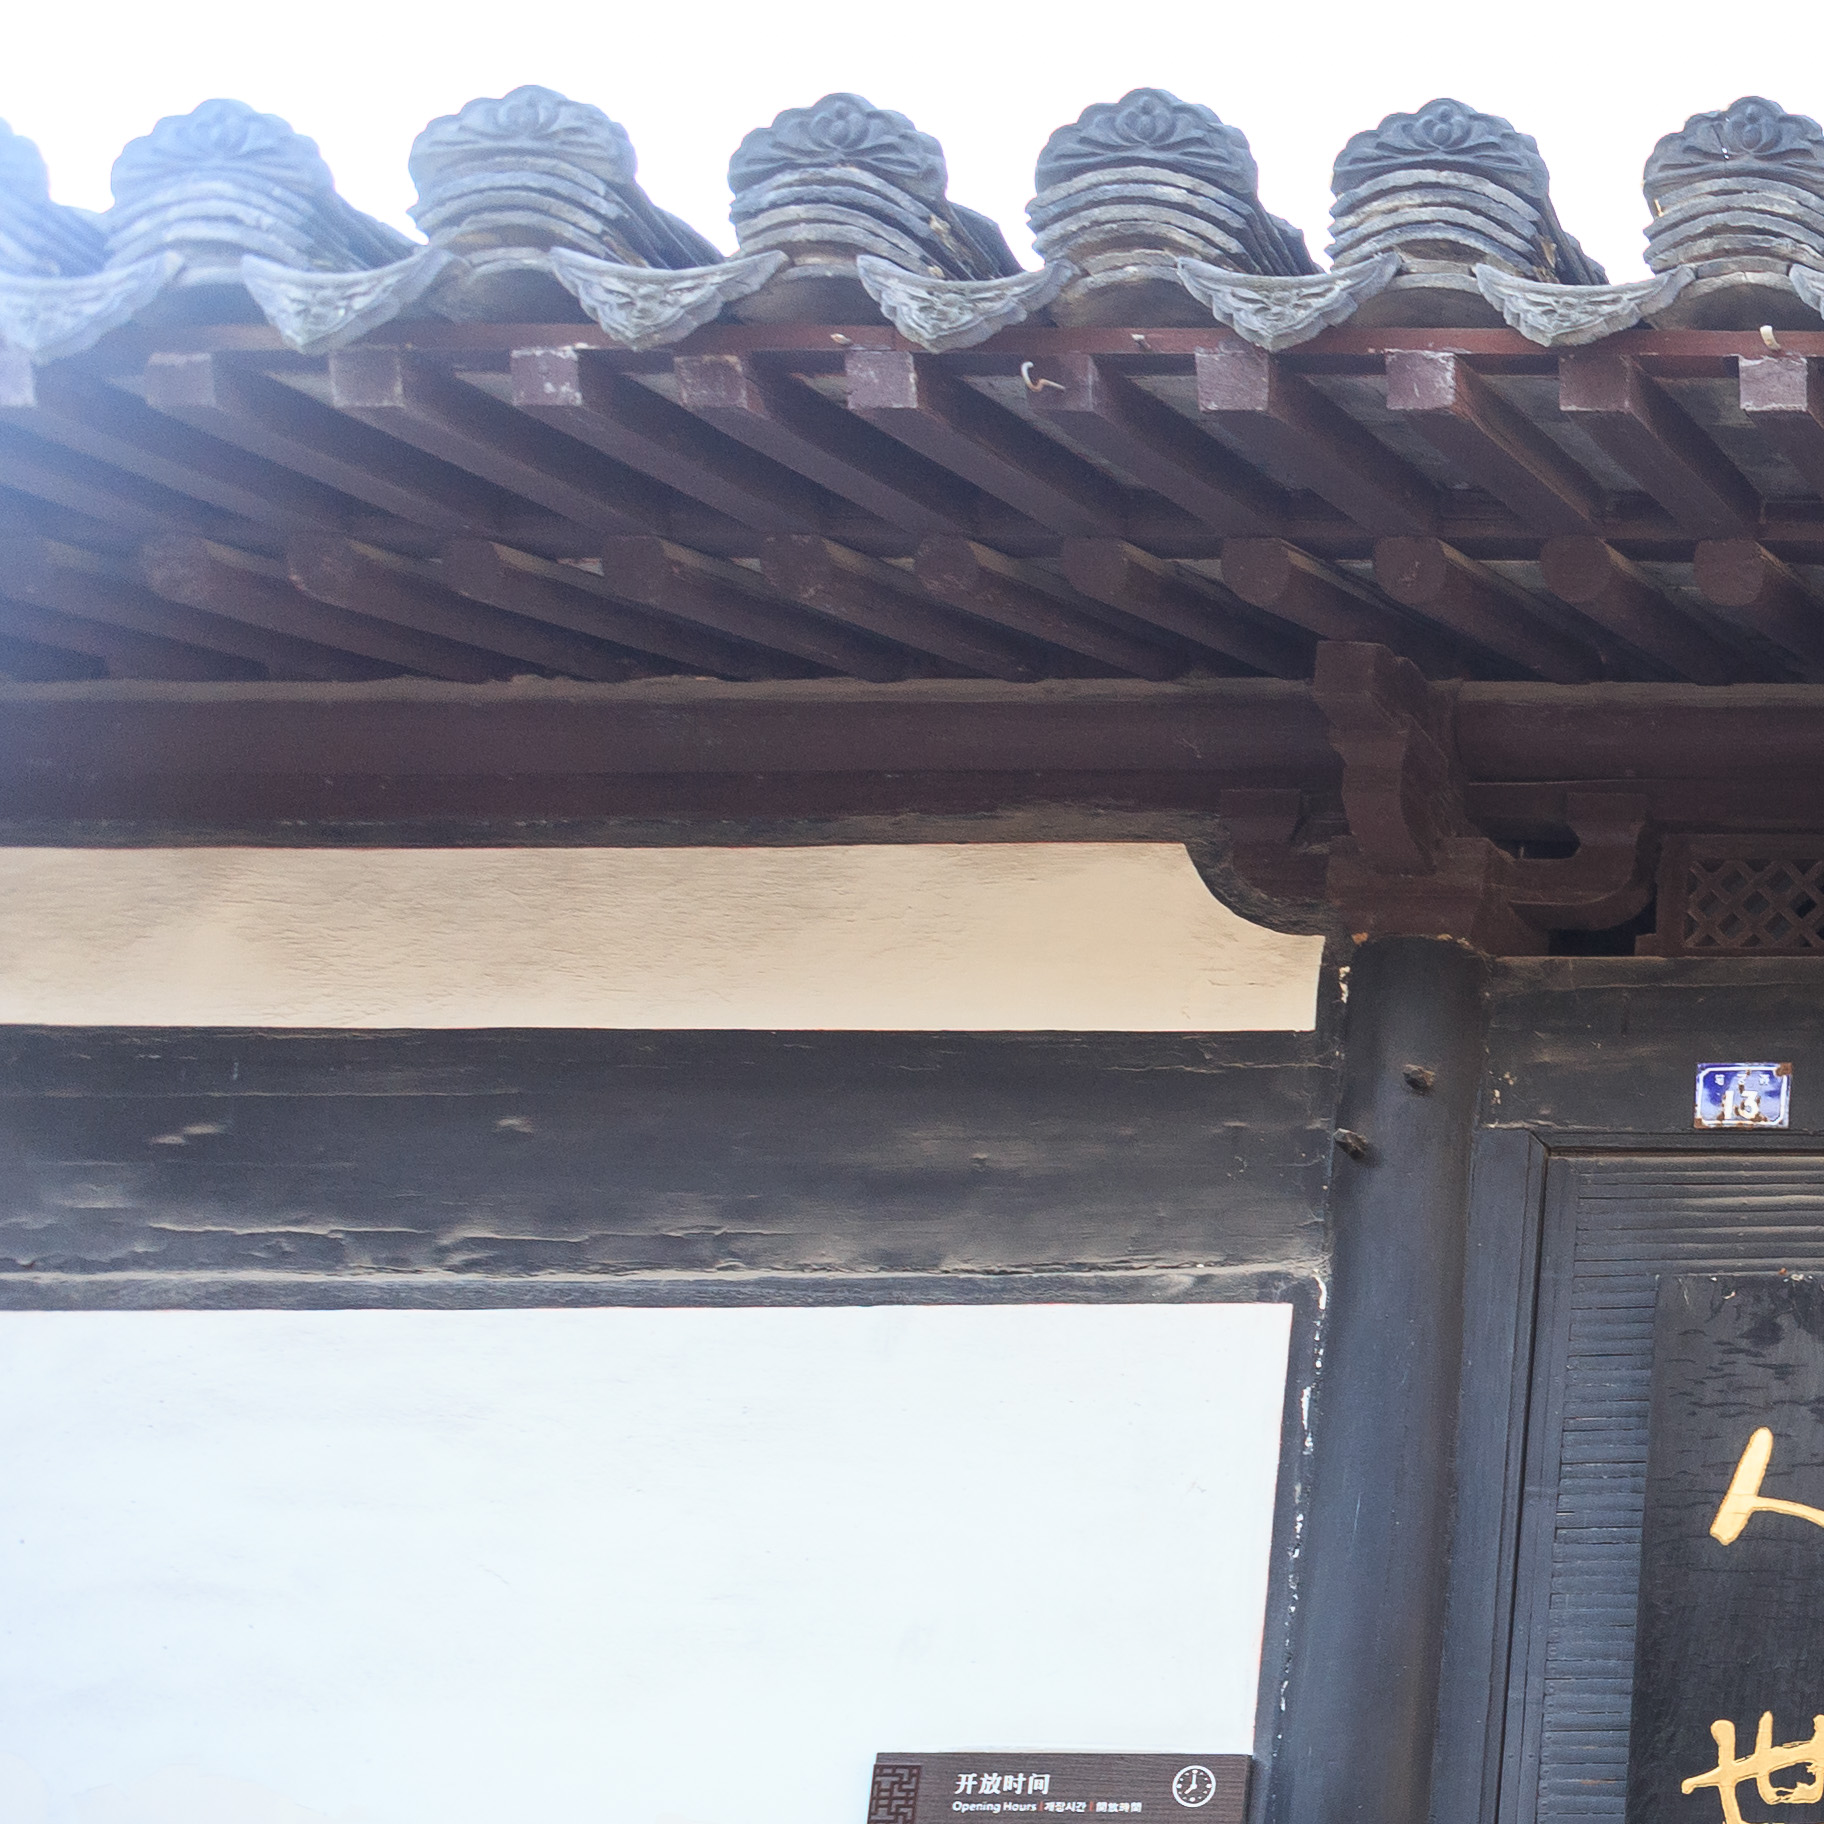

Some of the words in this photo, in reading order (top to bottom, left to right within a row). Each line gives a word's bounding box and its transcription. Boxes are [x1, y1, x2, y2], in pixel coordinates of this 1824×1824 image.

[1723, 1090, 1760, 1119] 13
[954, 1773, 1051, 1795] 开放时间
[952, 1801, 1001, 1813] Opening
[1003, 1801, 1037, 1812] Hours
